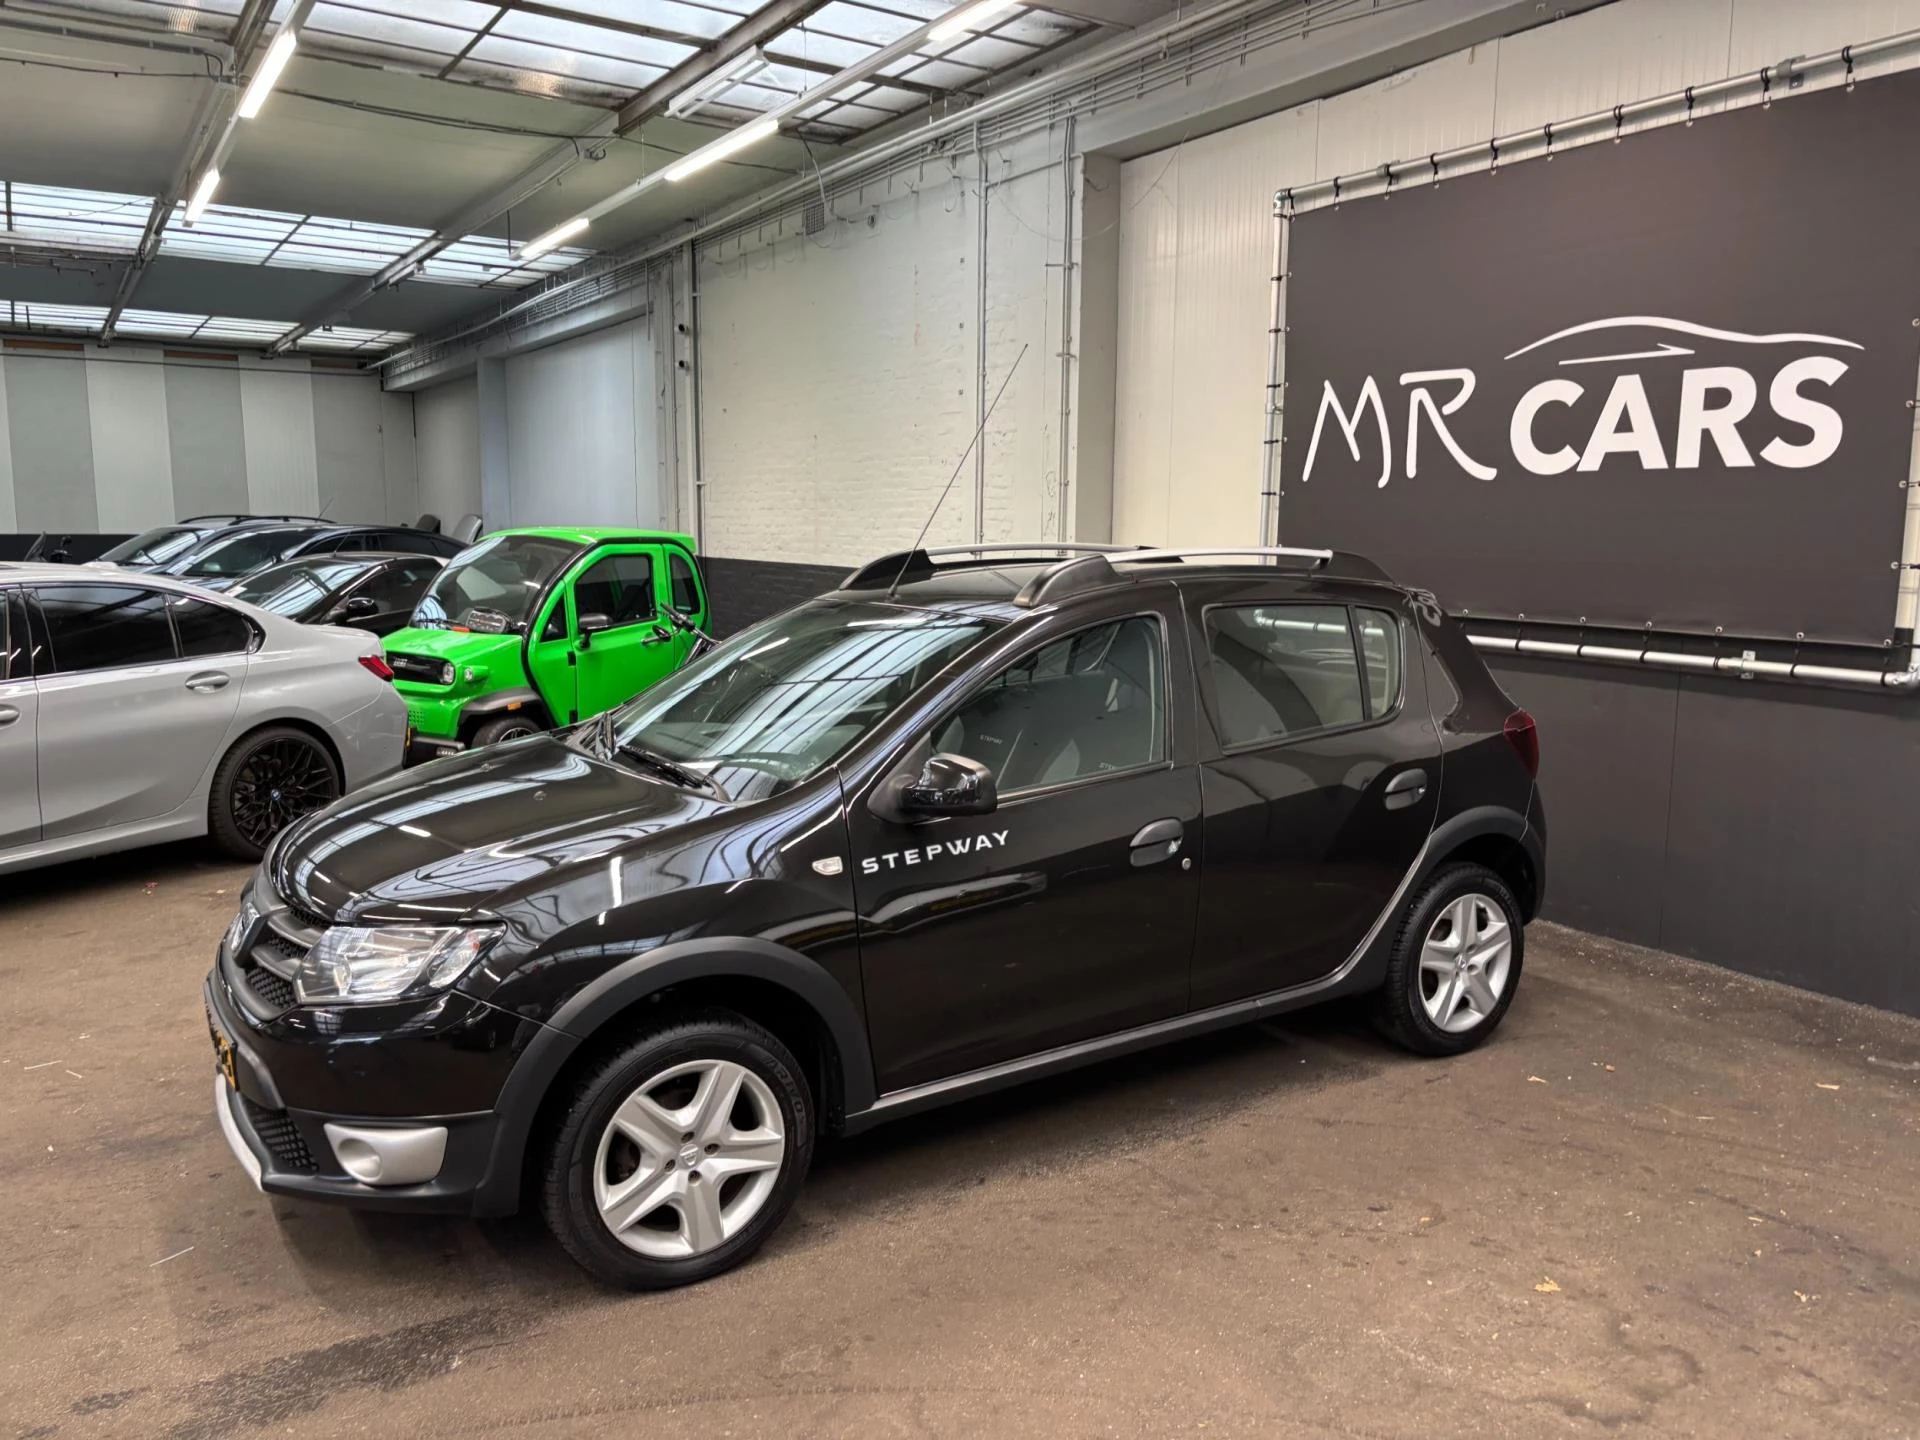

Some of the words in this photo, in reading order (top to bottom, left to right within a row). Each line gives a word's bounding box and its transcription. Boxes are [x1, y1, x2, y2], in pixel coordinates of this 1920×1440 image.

[1302, 368, 1497, 488] MR
[1509, 356, 1850, 475] CARS
[861, 829, 1009, 875] STEPWAY
